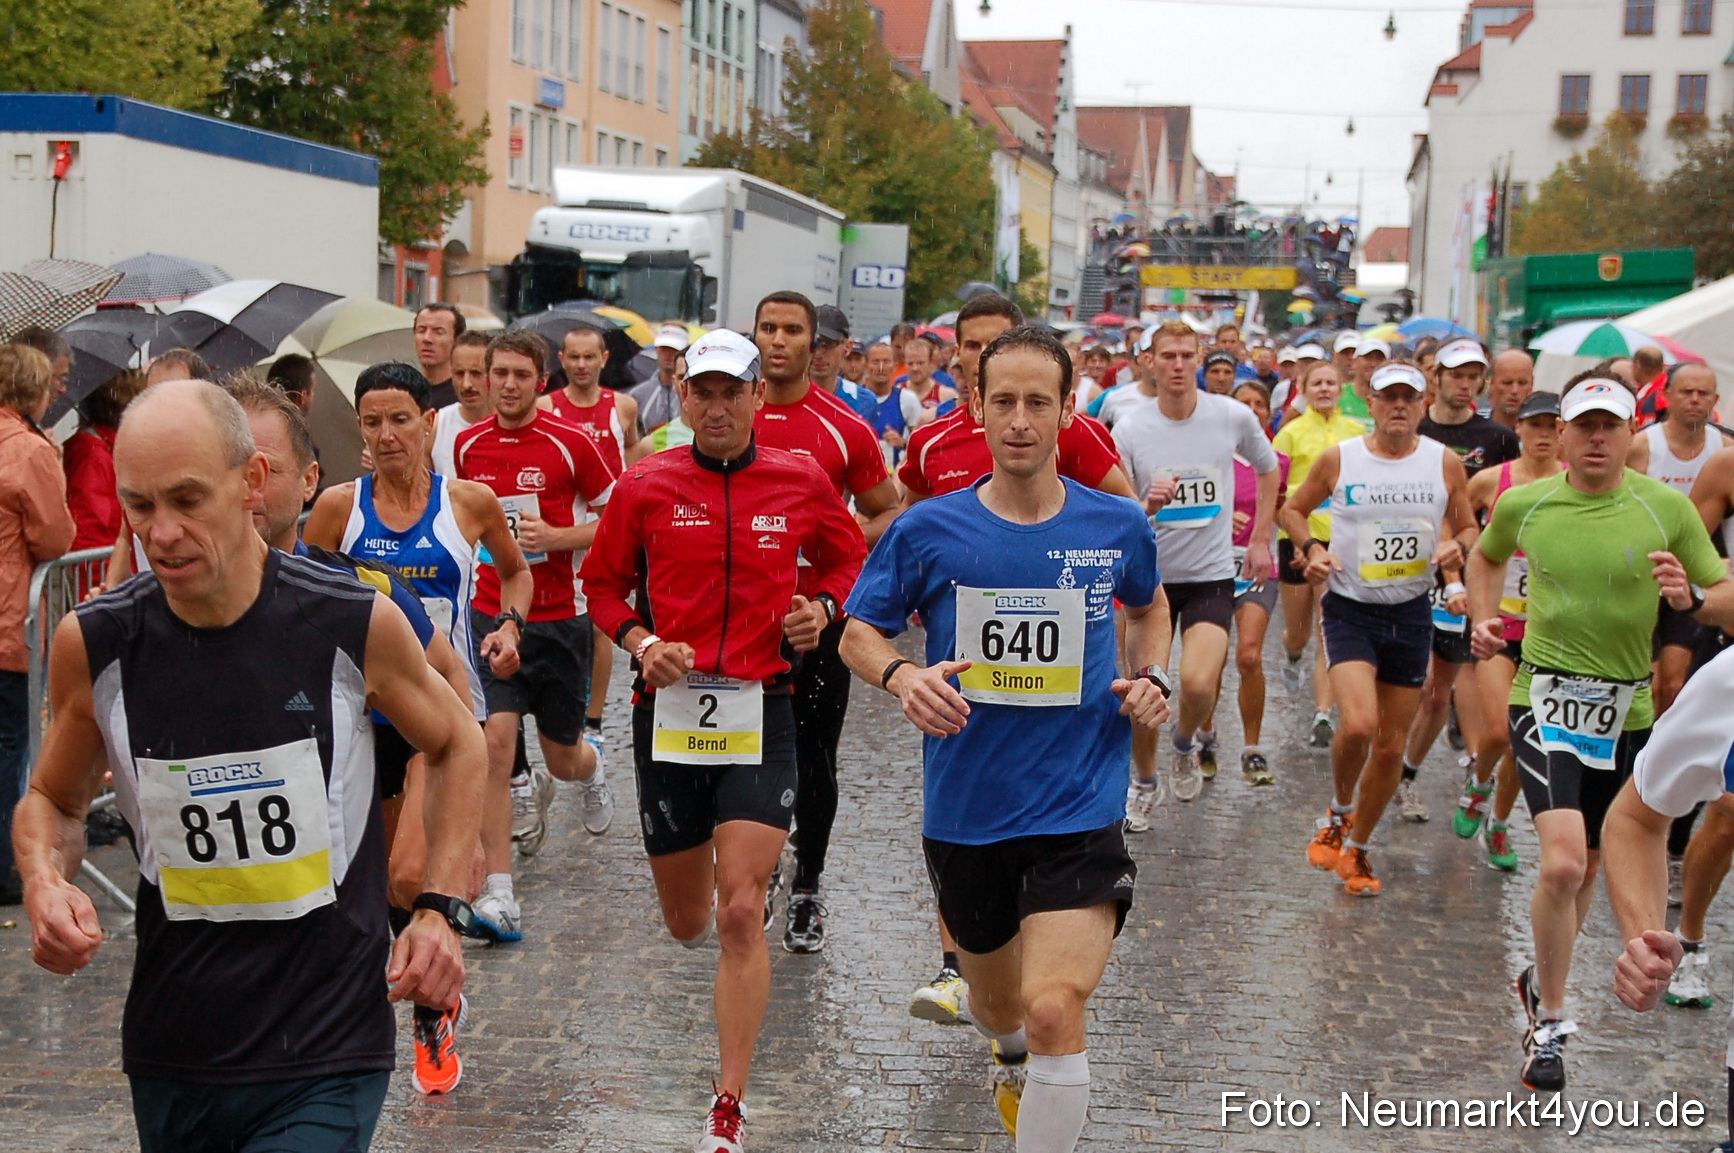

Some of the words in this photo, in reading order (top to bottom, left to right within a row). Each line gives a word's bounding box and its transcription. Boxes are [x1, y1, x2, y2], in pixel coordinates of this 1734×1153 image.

[569, 223, 651, 243] BOCK
[852, 264, 905, 289] BO
[1191, 271, 1243, 284] START
[1174, 480, 1216, 505] 419
[1369, 482, 1434, 492] HÖRGERÄTE
[1369, 492, 1435, 505] MECKLER
[673, 503, 707, 519] HDI
[752, 515, 787, 528] ARNDT
[364, 538, 400, 550] HEITEC
[1374, 536, 1418, 562] 323
[1046, 549, 1064, 560] 12.
[1064, 549, 1123, 560] NEUMARKTER
[1063, 558, 1115, 567] STADTLAUF
[995, 596, 1046, 608] BOCK
[981, 619, 1060, 663] 640
[991, 670, 1045, 690] Simon
[698, 693, 718, 729] 2
[1542, 697, 1618, 736] 2079
[687, 736, 728, 751] Bernd
[187, 762, 263, 787] BOCK
[180, 794, 297, 864] 818
